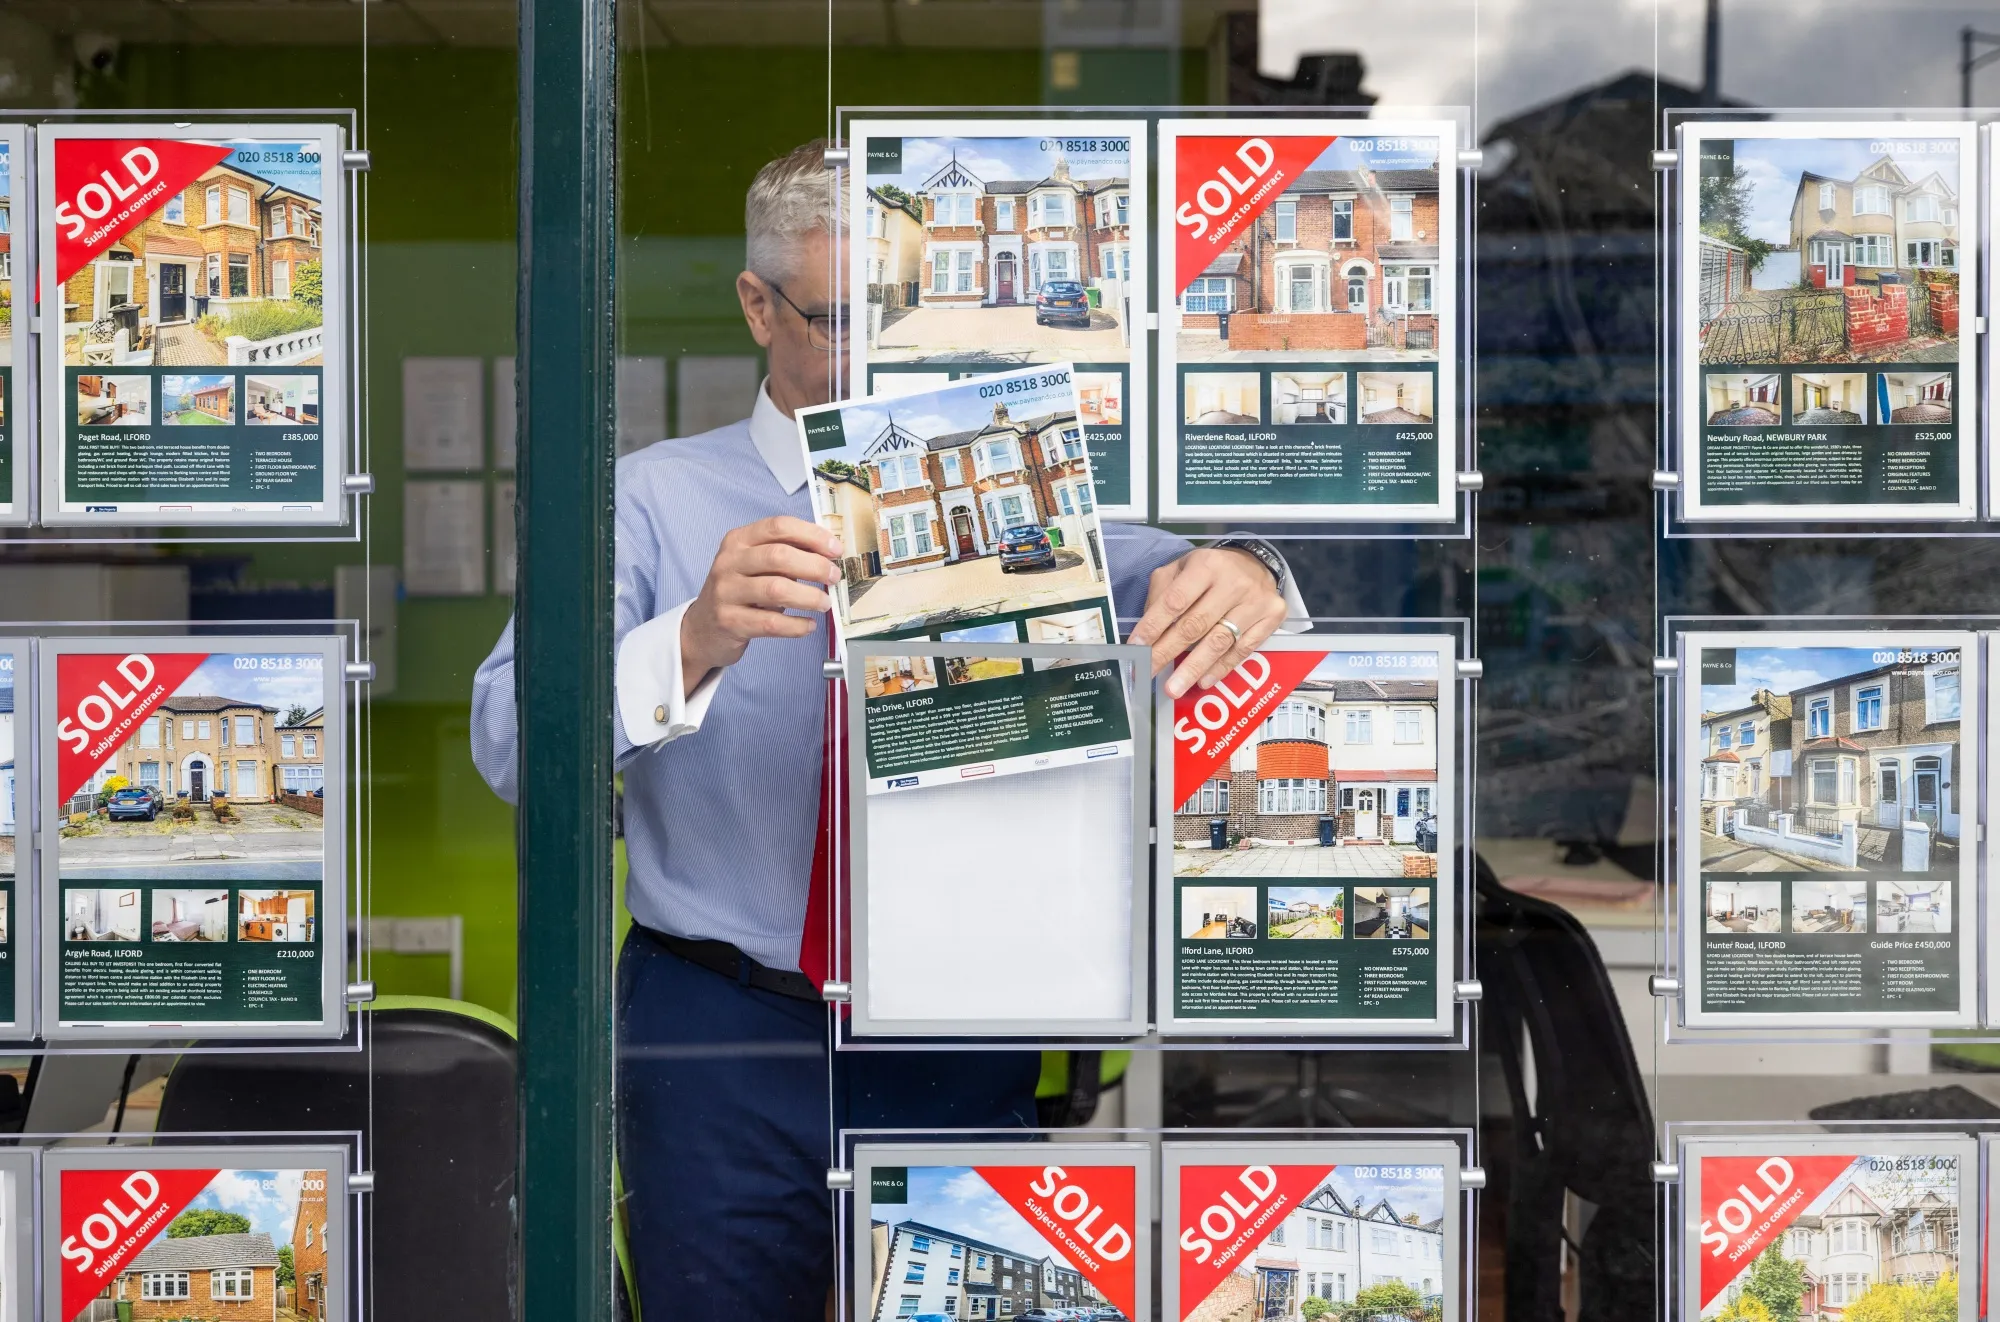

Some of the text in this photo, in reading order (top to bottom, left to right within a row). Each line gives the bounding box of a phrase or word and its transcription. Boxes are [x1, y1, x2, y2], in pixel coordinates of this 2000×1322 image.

[1040, 140, 1062, 151] 020
[1067, 141, 1096, 151] 8518
[1350, 140, 1373, 151] 020
[1377, 140, 1407, 151] 8518
[238, 152, 321, 163] 020 8518 300
[56, 145, 160, 240] SOLD
[1176, 138, 1274, 239] SOLD
[1208, 170, 1284, 244] Subject to contract
[84, 181, 167, 248] Subject to contract
[980, 384, 1003, 398] 020
[1006, 378, 1037, 394] 8518
[1085, 433, 1121, 442] £425,000
[1225, 433, 1246, 442] Road,
[1707, 434, 1741, 443] Newbury
[1743, 434, 1764, 442] Road,
[1915, 432, 1951, 441] £525,000
[234, 658, 257, 669] 020
[261, 658, 292, 669] 8518
[1349, 656, 1372, 667] 020
[1376, 656, 1407, 667] 8518
[1873, 652, 1894, 663] 020
[1898, 652, 1927, 663] 8518
[1075, 669, 1112, 681] £425,000
[58, 654, 155, 755] SOLD
[866, 698, 934, 714] The Drive, ILFORD
[1174, 652, 1271, 754] SOLD
[89, 684, 165, 760] Subject to contract
[1207, 682, 1282, 759] Subject to contract
[1735, 942, 1756, 950] Road,
[1915, 941, 1950, 949] £450,000
[65, 950, 89, 958] Argyle
[91, 950, 112, 958] Road,
[277, 950, 314, 959] £210,000
[1204, 947, 1223, 956] Lane,
[1392, 948, 1429, 956] £575,000
[1870, 1161, 1893, 1171] 020
[1896, 1160, 1925, 1171] 8518
[1354, 1167, 1378, 1178] 020
[1381, 1168, 1412, 1179] 8518
[1701, 1156, 1794, 1258] SOLD
[1029, 1166, 1132, 1262] SOLD
[1180, 1165, 1277, 1264] SOLD
[61, 1171, 160, 1273] SOLD
[1728, 1188, 1804, 1262] Subject to contract
[1025, 1198, 1101, 1272] Subject to contract
[1212, 1194, 1288, 1269] Subject to contract
[94, 1202, 170, 1279] Subject to contract
